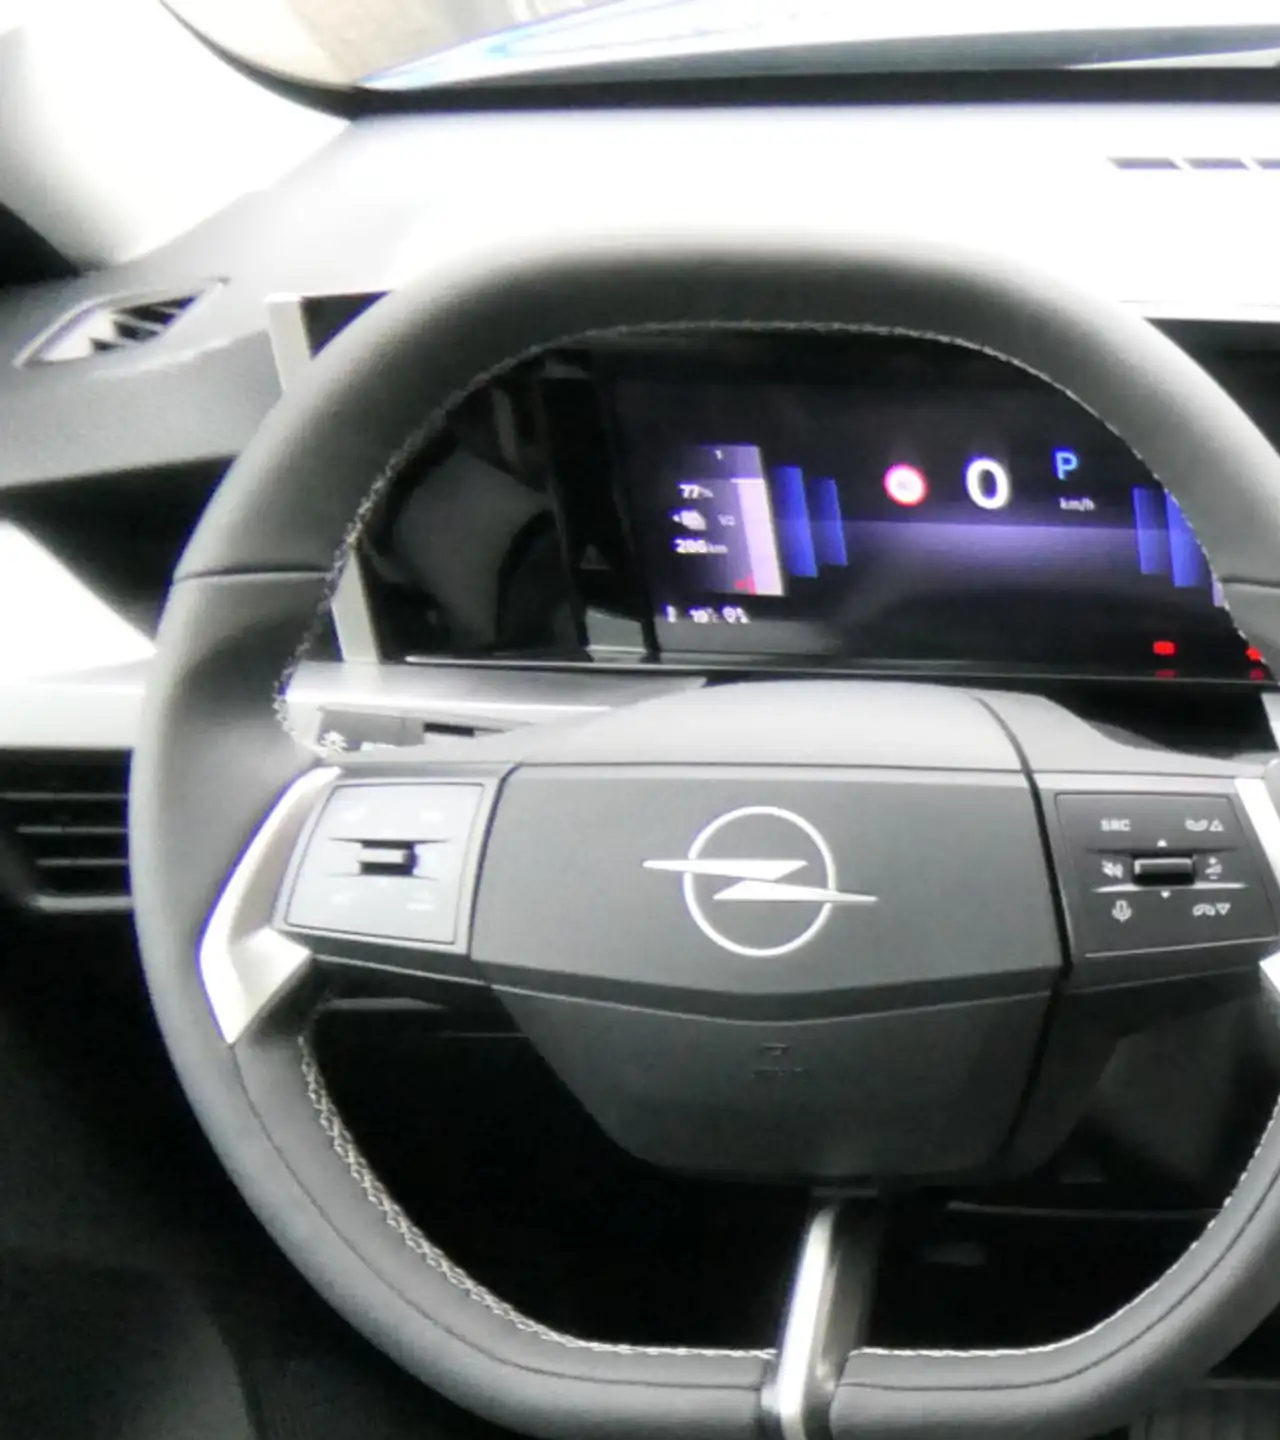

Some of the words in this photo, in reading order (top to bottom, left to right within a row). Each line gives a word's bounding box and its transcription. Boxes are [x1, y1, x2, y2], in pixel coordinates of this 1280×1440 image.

[1054, 451, 1078, 480] P
[965, 457, 1010, 509] 0
[1059, 497, 1095, 511] km/h
[1100, 818, 1132, 833] SRC
